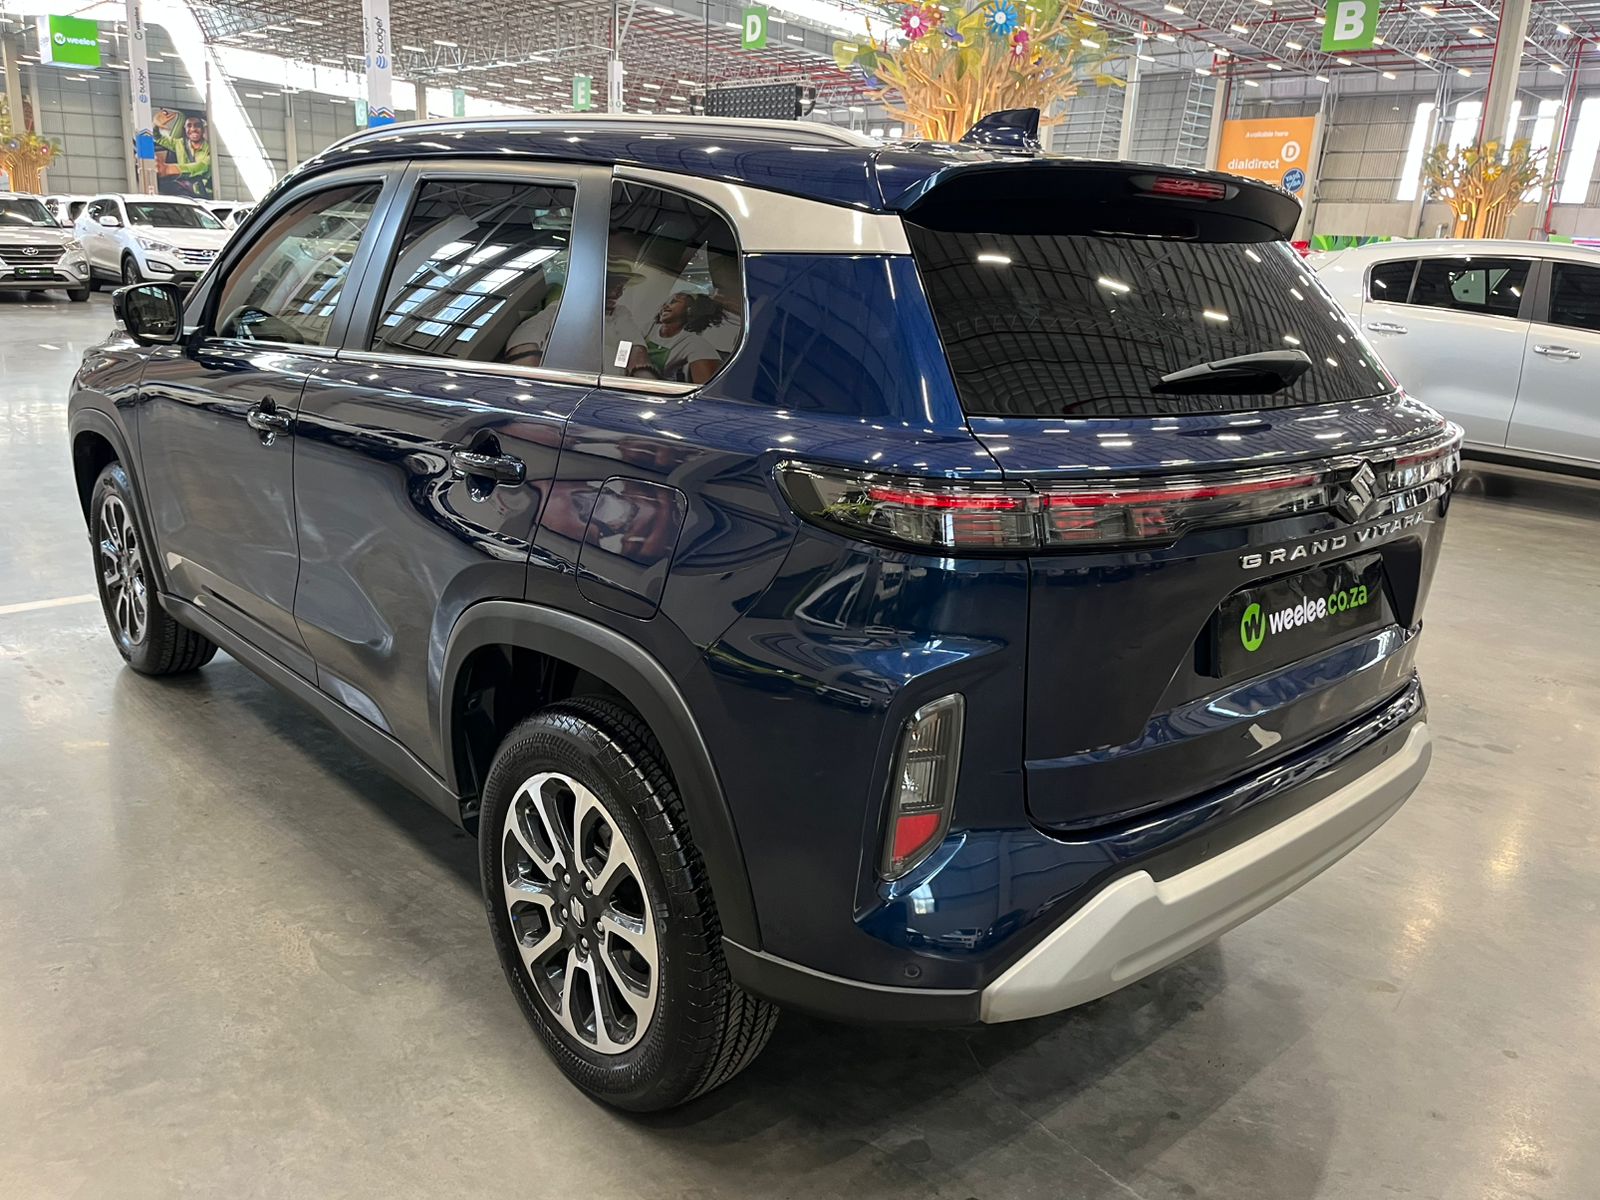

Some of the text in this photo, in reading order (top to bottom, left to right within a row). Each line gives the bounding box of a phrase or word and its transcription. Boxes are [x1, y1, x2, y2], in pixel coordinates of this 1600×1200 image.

[374, 16, 386, 54] budget
[745, 14, 762, 43] D
[1333, 1, 1366, 41] B
[66, 36, 96, 46] weelee
[577, 81, 586, 105] E
[1227, 158, 1280, 170] dialdirect
[1240, 511, 1427, 569] GRAND VITARA
[1269, 584, 1368, 635] weelee.co.za
